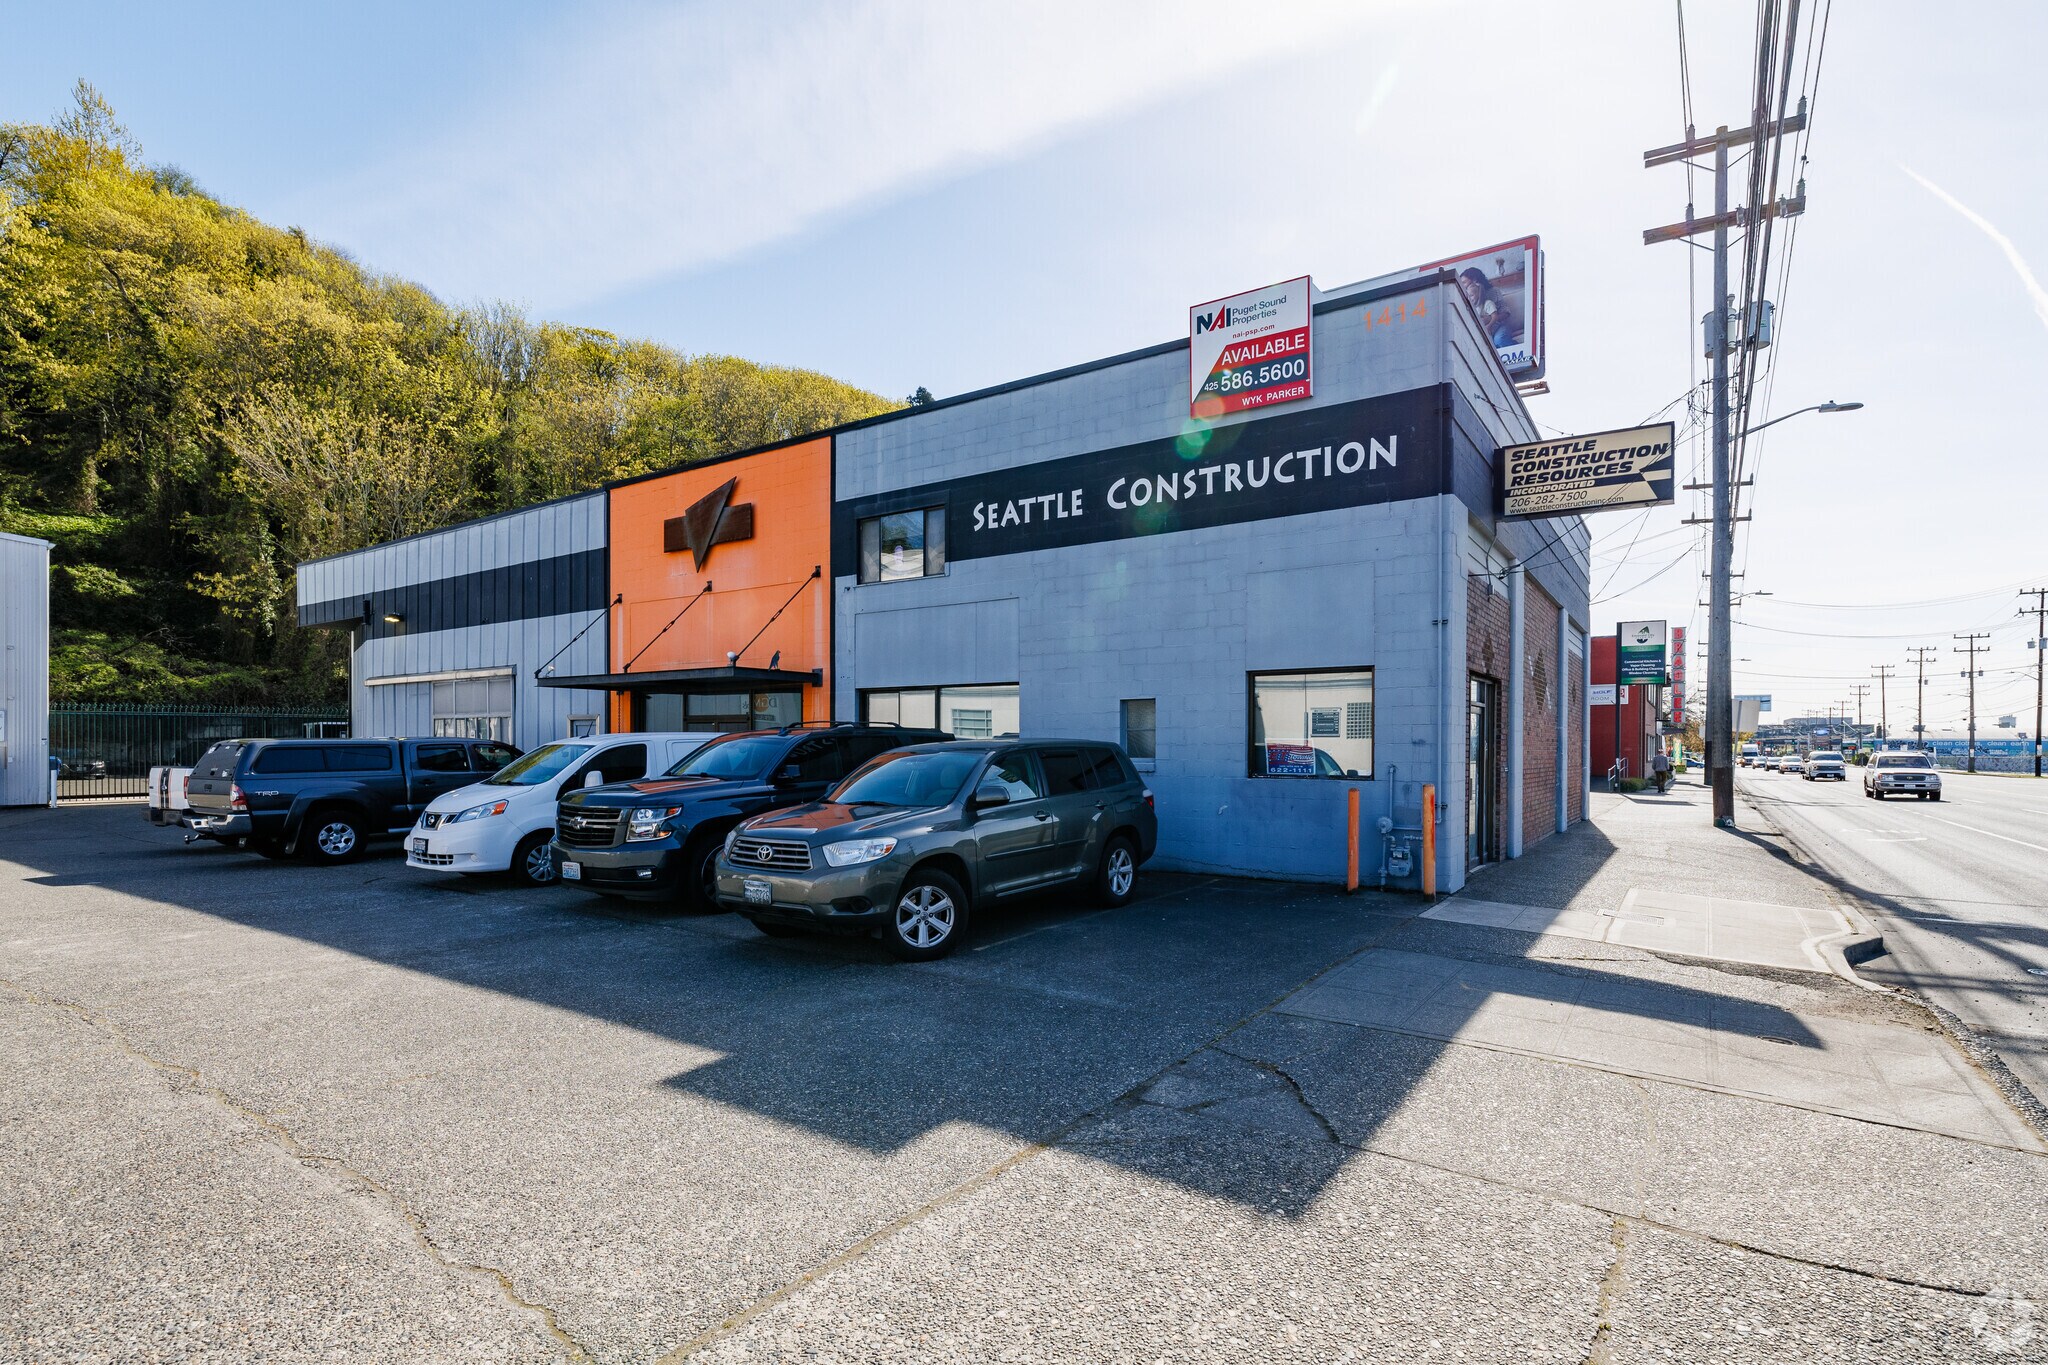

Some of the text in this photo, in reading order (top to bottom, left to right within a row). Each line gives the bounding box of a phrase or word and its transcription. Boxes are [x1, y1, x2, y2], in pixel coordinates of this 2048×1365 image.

[1232, 295, 1287, 317] Puget Sound
[1232, 308, 1277, 326] Properties
[1363, 297, 1428, 332] 1414
[1197, 304, 1231, 334] NAI
[1232, 323, 1275, 339] nai-psp.com
[1221, 333, 1305, 366] AVAILABLE
[1204, 359, 1305, 392] 425 586.5600
[1242, 386, 1305, 406] WYK PARKER
[1511, 439, 1597, 462] SEATTLE
[1511, 443, 1669, 475] CONSTRUCTION
[973, 435, 1398, 532] SEATTLE CONSTRUCTION
[1510, 461, 1633, 488] RESOURCES
[1510, 479, 1595, 497] INCORPORATED
[1511, 490, 1588, 508] 206-282-7500
